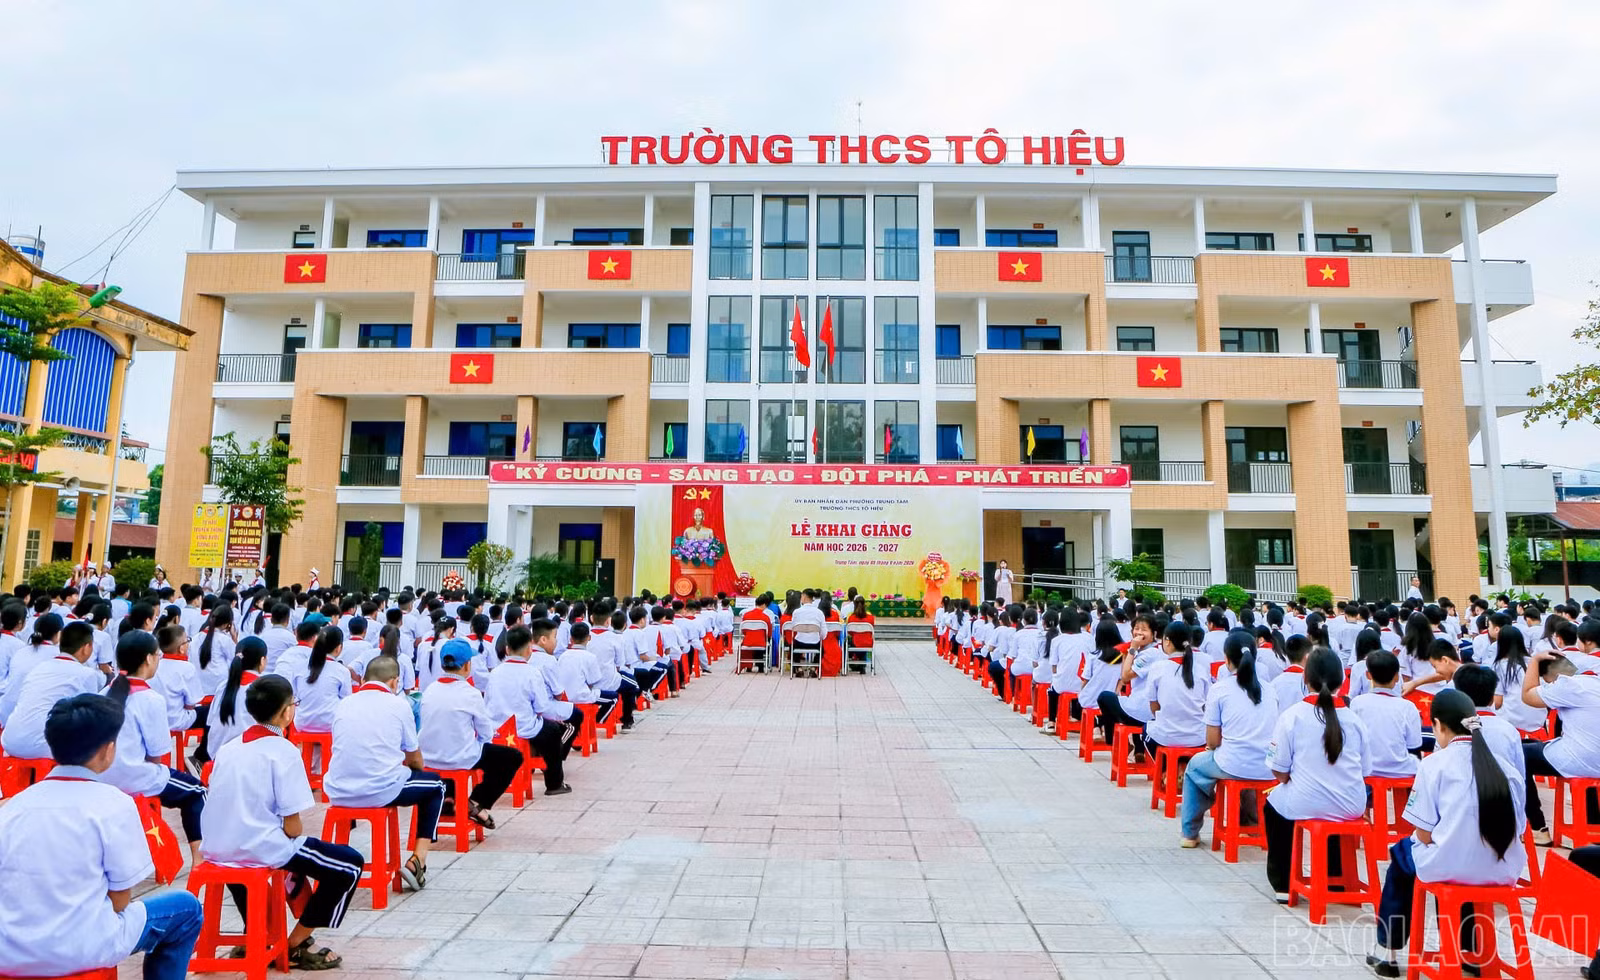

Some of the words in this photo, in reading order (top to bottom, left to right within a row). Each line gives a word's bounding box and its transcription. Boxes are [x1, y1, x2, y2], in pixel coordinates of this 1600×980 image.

[601, 128, 793, 165] TRƯỜNG
[808, 134, 932, 164] THCS
[946, 128, 1007, 164] TÔ
[1023, 128, 1125, 176] HIỆU
[556, 466, 642, 481] CƯƠNG
[668, 466, 739, 482] SÁNG
[746, 469, 795, 484] TẠO
[820, 468, 870, 485] ĐỘT
[877, 468, 930, 484] PHÁ
[956, 468, 1022, 484] PHÁT
[791, 518, 811, 536] LỄ
[815, 524, 856, 536] KHAI
[861, 520, 912, 537] GIẢNG
[826, 543, 844, 553] HỌC
[846, 543, 867, 552] 2026
[878, 544, 899, 552] 2027
